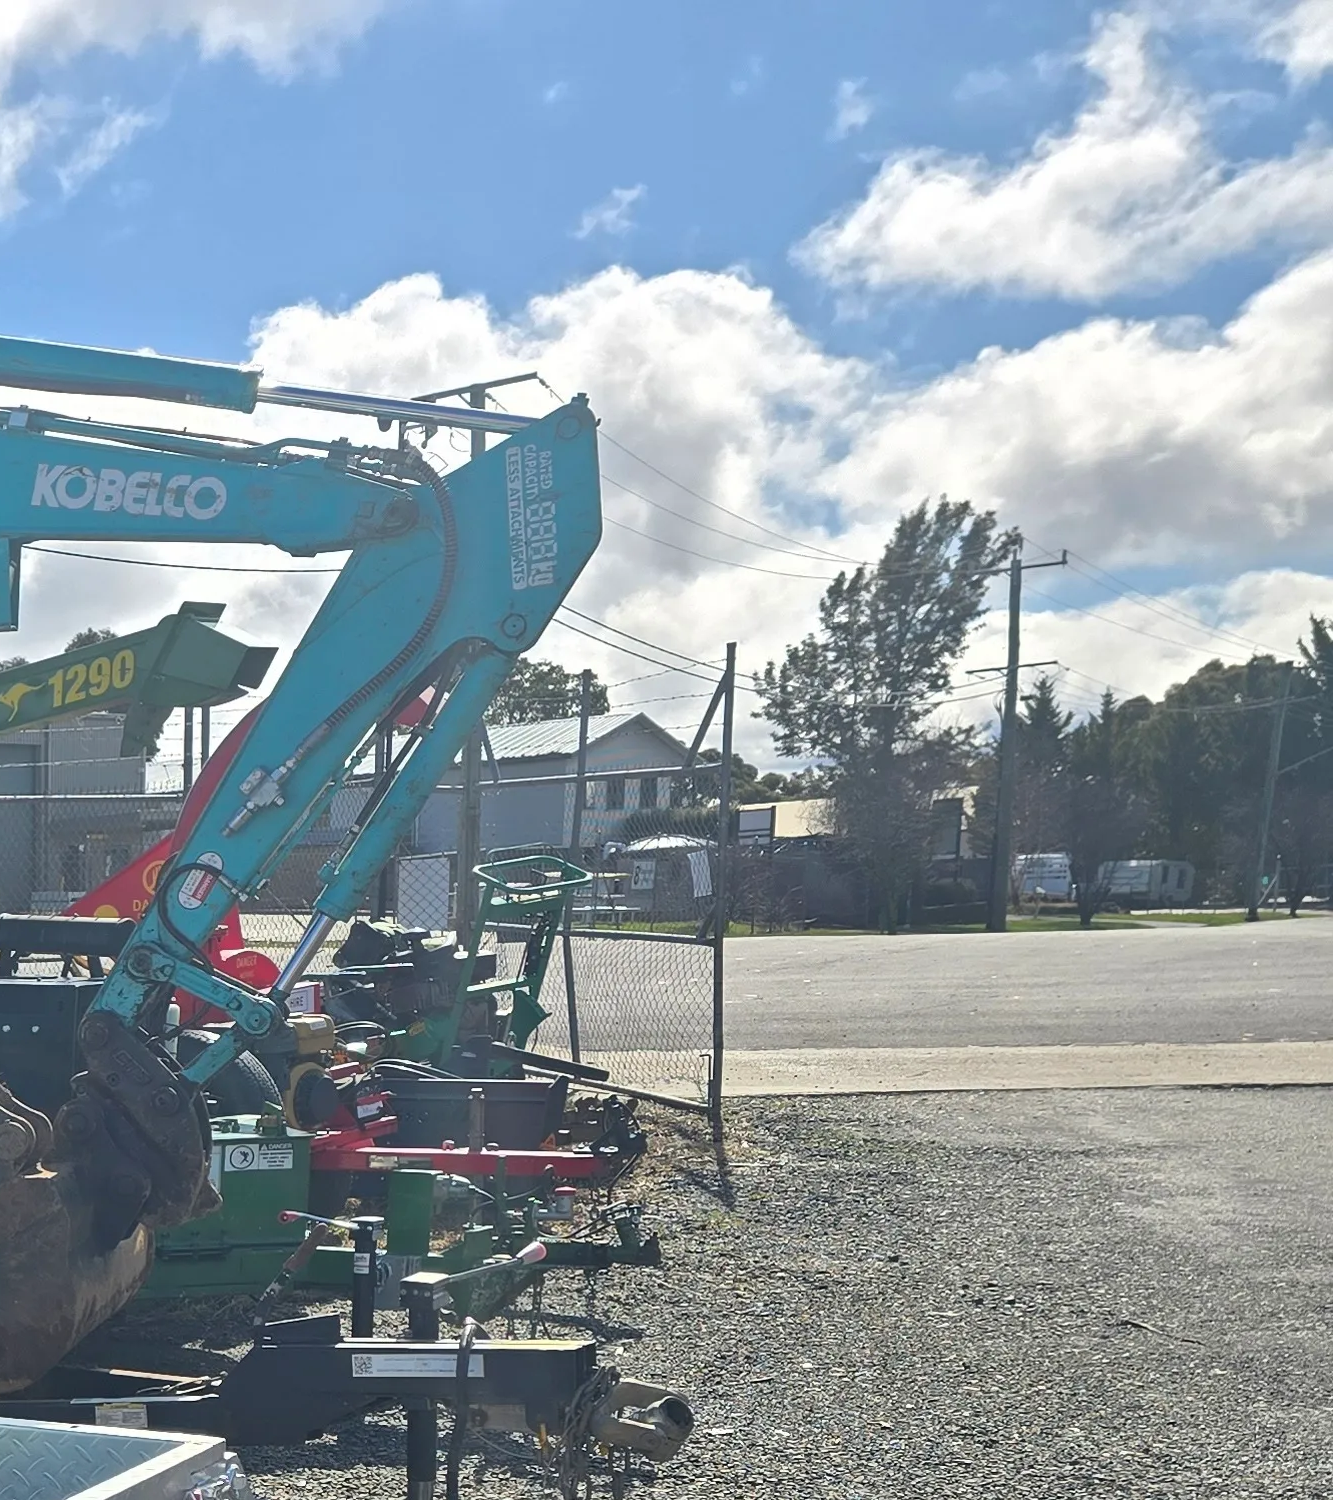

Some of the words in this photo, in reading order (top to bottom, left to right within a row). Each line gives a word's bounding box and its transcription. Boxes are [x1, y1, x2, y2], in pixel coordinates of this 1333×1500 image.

[31, 463, 227, 520] KOBELCO
[507, 453, 520, 484] LESS
[538, 450, 553, 489] RATED
[509, 487, 526, 584] ATTACHMENTS
[48, 649, 135, 708] 1290
